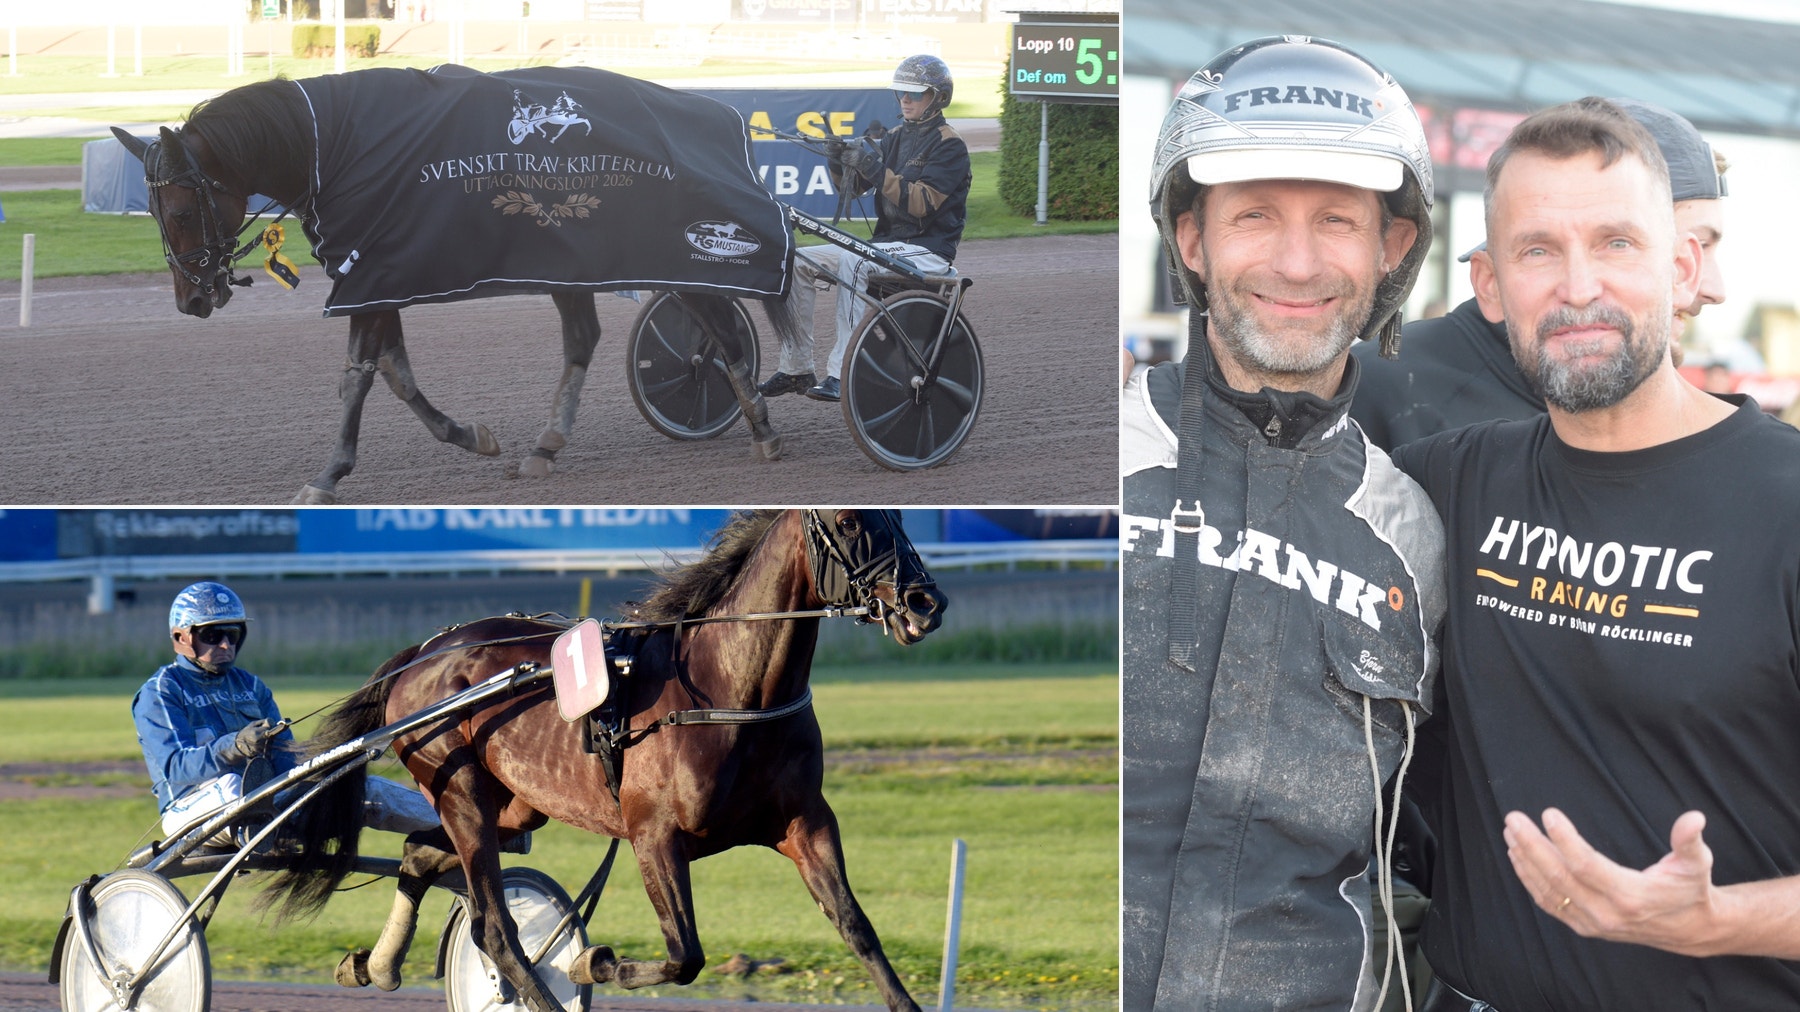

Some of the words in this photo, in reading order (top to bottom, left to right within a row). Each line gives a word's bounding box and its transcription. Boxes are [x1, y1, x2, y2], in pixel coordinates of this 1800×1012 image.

[1017, 36, 1054, 54] Lopp
[1057, 37, 1075, 51] 10
[1016, 68, 1042, 83] Def
[1043, 73, 1067, 84] om
[1225, 85, 1373, 119] FRANK
[419, 152, 509, 183] SVENSKT
[464, 172, 599, 194] UTTAGNINGSLOPP
[602, 174, 634, 188] 2026
[713, 239, 754, 254] MUSTANG
[854, 240, 877, 258] EPIC
[728, 258, 750, 266] FODER
[1479, 516, 1714, 594] HYPNOTIC
[1123, 514, 1387, 632] FRANK
[1548, 613, 1567, 627] BY
[1601, 624, 1694, 647] RÖCKLINGER
[566, 629, 588, 690] 1
